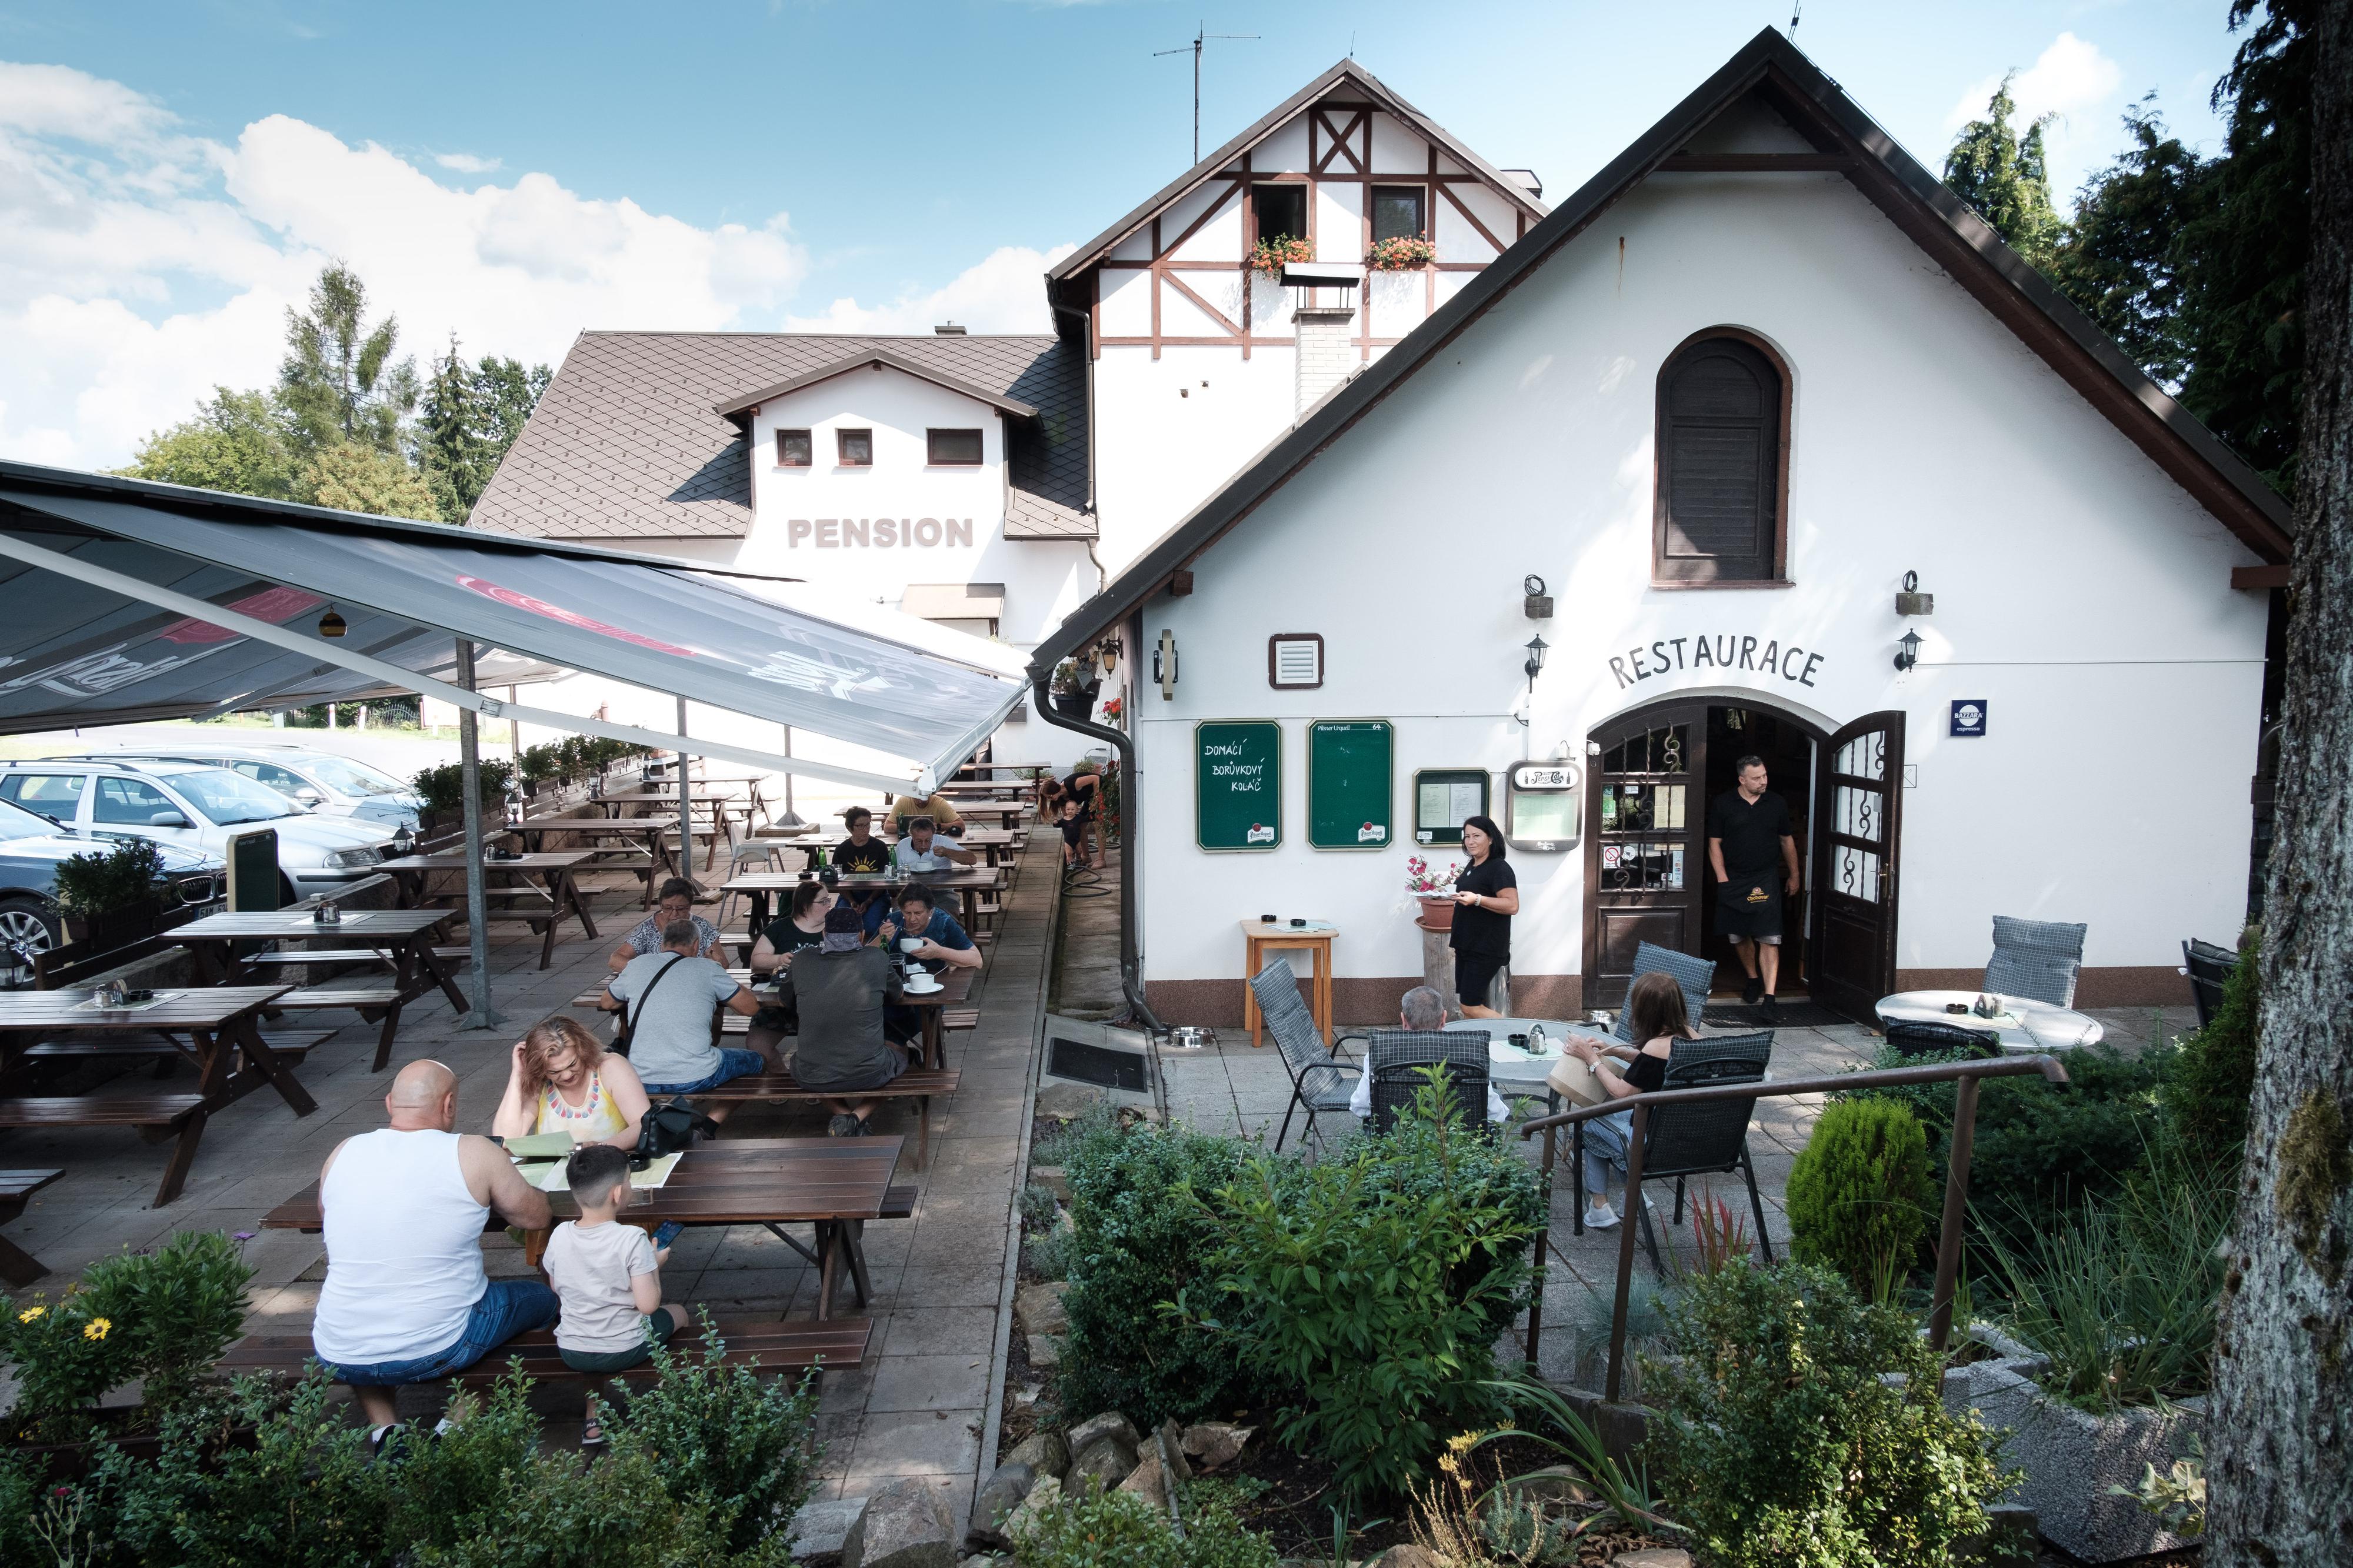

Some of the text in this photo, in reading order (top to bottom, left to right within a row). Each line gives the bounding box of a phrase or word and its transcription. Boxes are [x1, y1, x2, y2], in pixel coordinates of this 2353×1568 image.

[788, 518, 973, 548] PENSION
[1608, 635, 1825, 689] RESTAURACE
[1205, 738, 1248, 756] DOMÁCÍ
[1212, 758, 1265, 775] BORŮVKOVÝ
[1231, 778, 1262, 792] KOLÁČ
